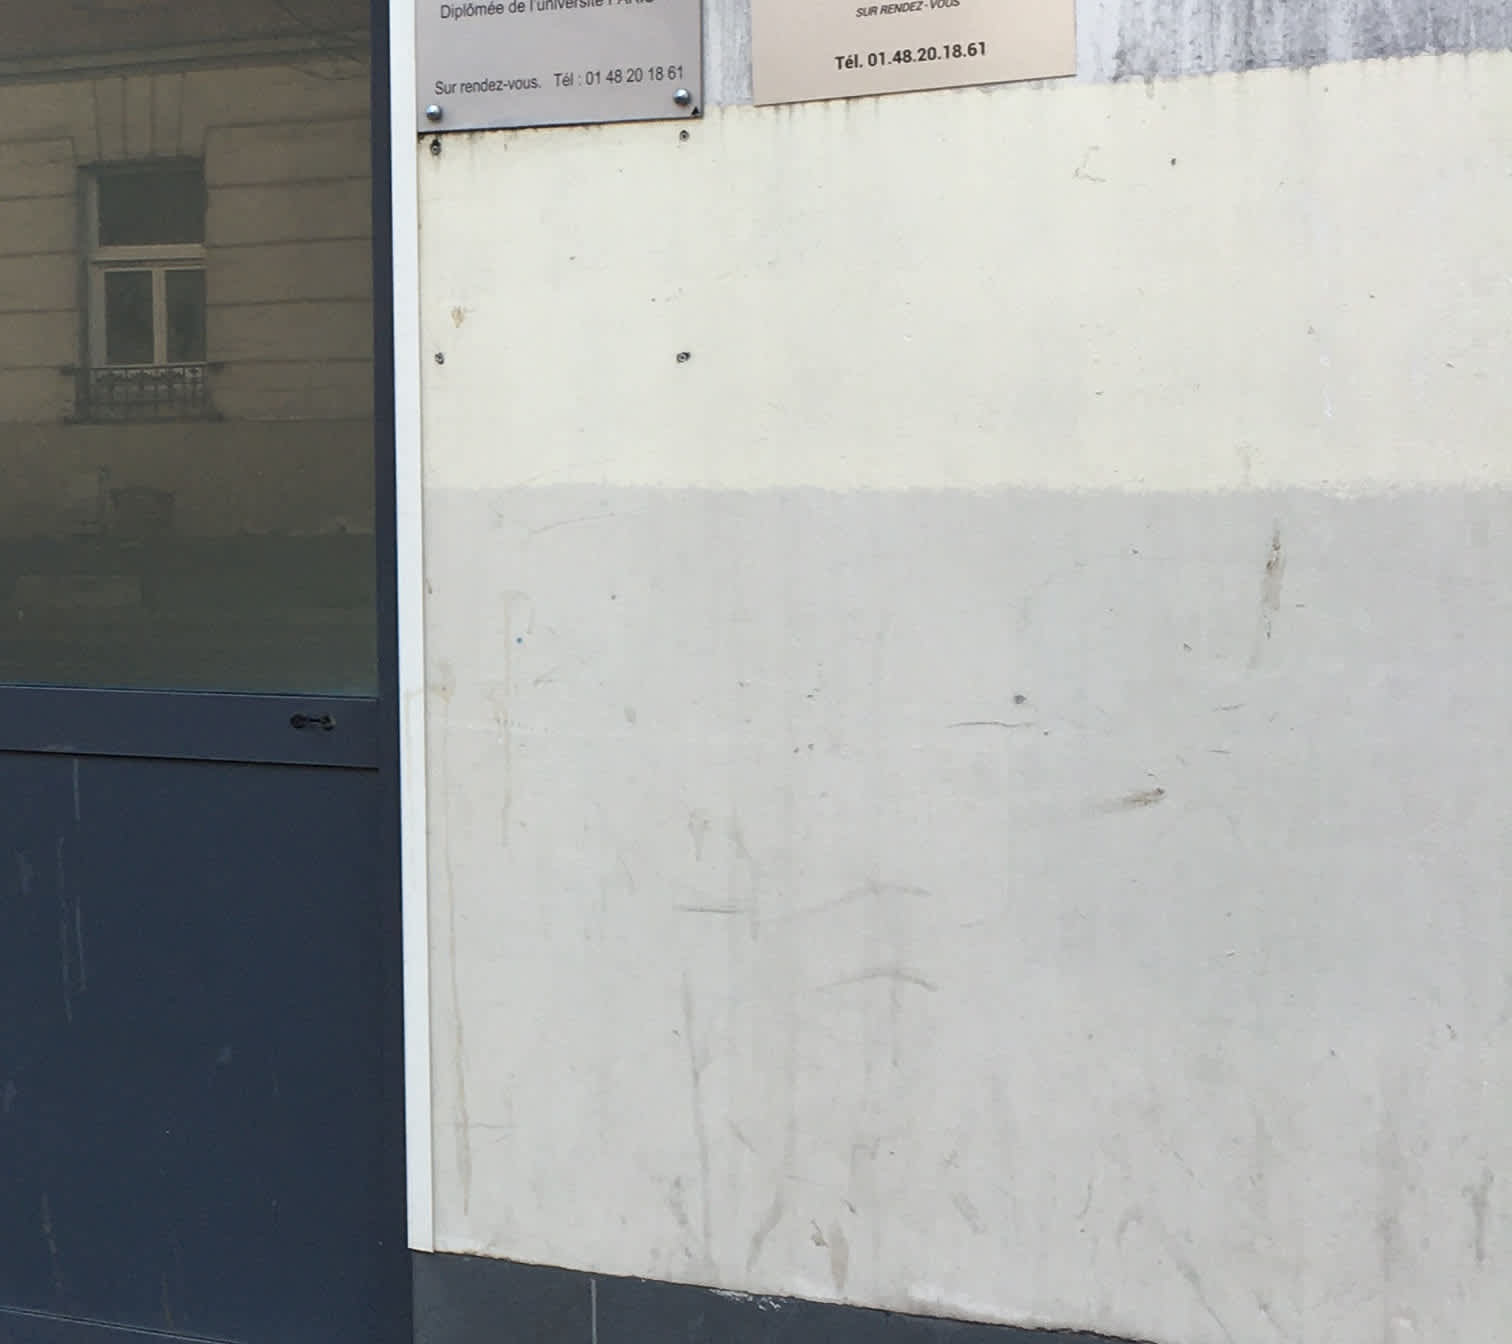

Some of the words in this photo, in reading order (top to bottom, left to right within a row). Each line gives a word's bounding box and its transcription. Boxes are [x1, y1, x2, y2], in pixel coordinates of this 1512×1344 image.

[440, 2, 504, 21] Diplômée
[508, 0, 525, 14] de
[856, 6, 878, 18] SUR
[835, 54, 863, 70] Tél.
[868, 41, 986, 67] 01.48.20.18.61
[435, 80, 456, 95] Sur
[460, 76, 541, 93] rendez-vous.
[585, 71, 601, 86] 01
[606, 69, 622, 84] 48
[626, 67, 643, 83] 20
[648, 66, 664, 81] 18
[667, 65, 684, 80] 61
